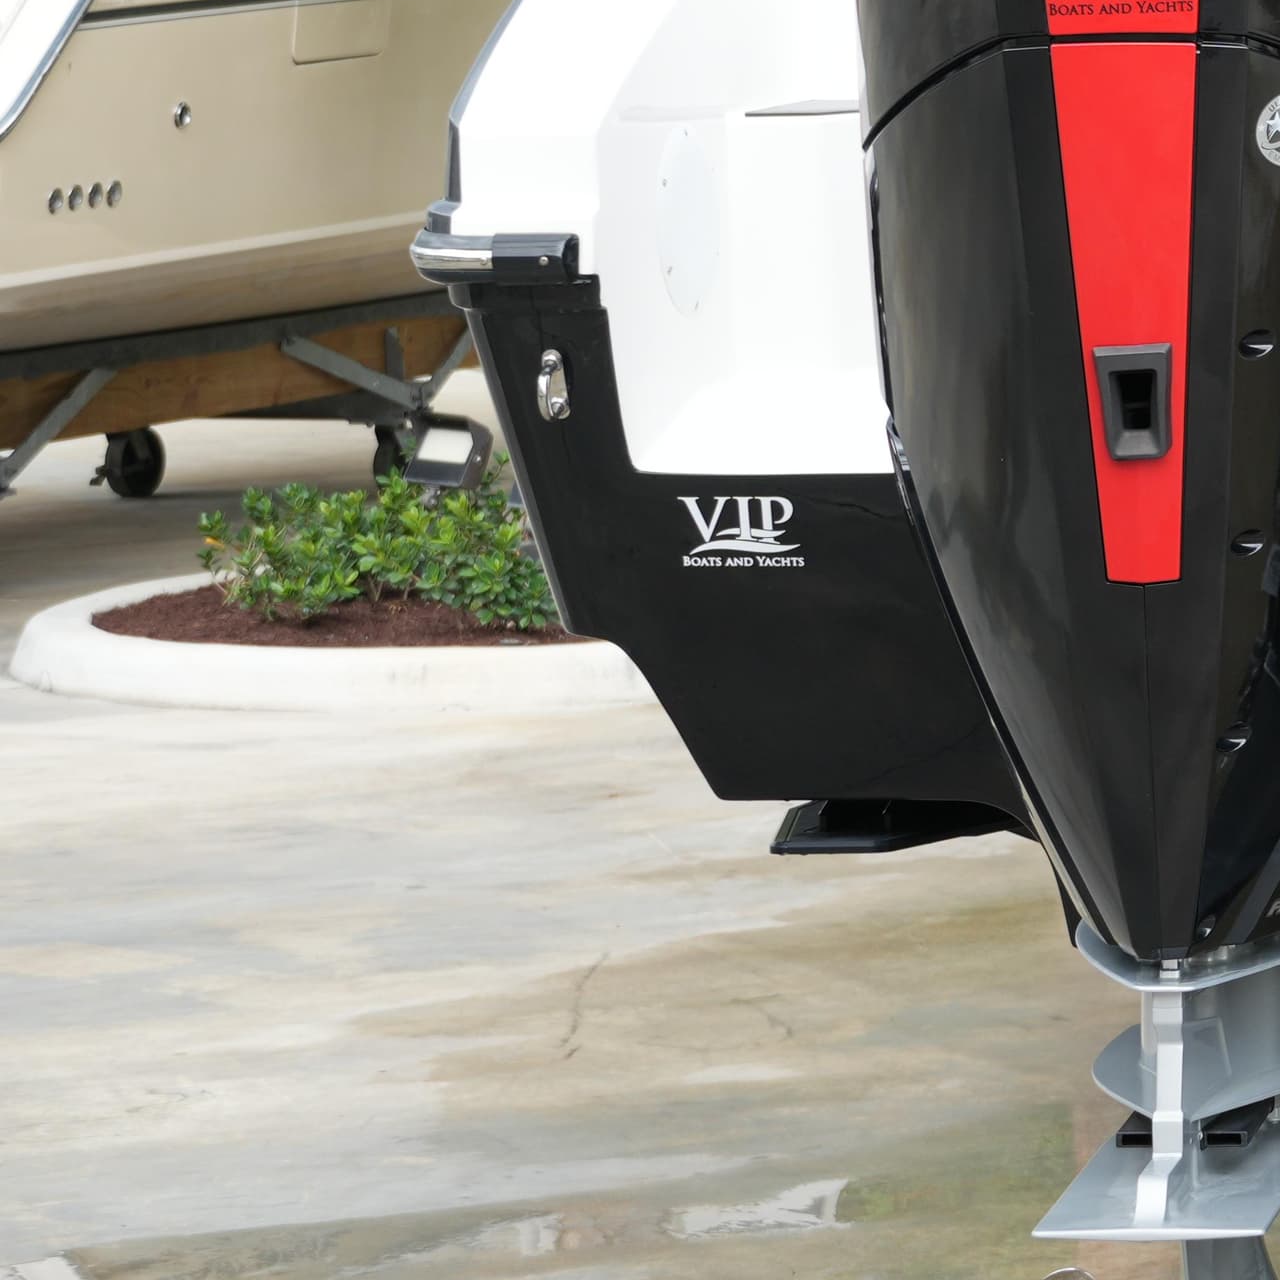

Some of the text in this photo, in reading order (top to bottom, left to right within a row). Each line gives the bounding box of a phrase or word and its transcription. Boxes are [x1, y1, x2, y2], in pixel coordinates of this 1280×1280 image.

[1049, 1, 1193, 16] BOATS AND YACHTS
[677, 496, 793, 544] VIP
[682, 556, 805, 567] BOATS AND YACHTS
